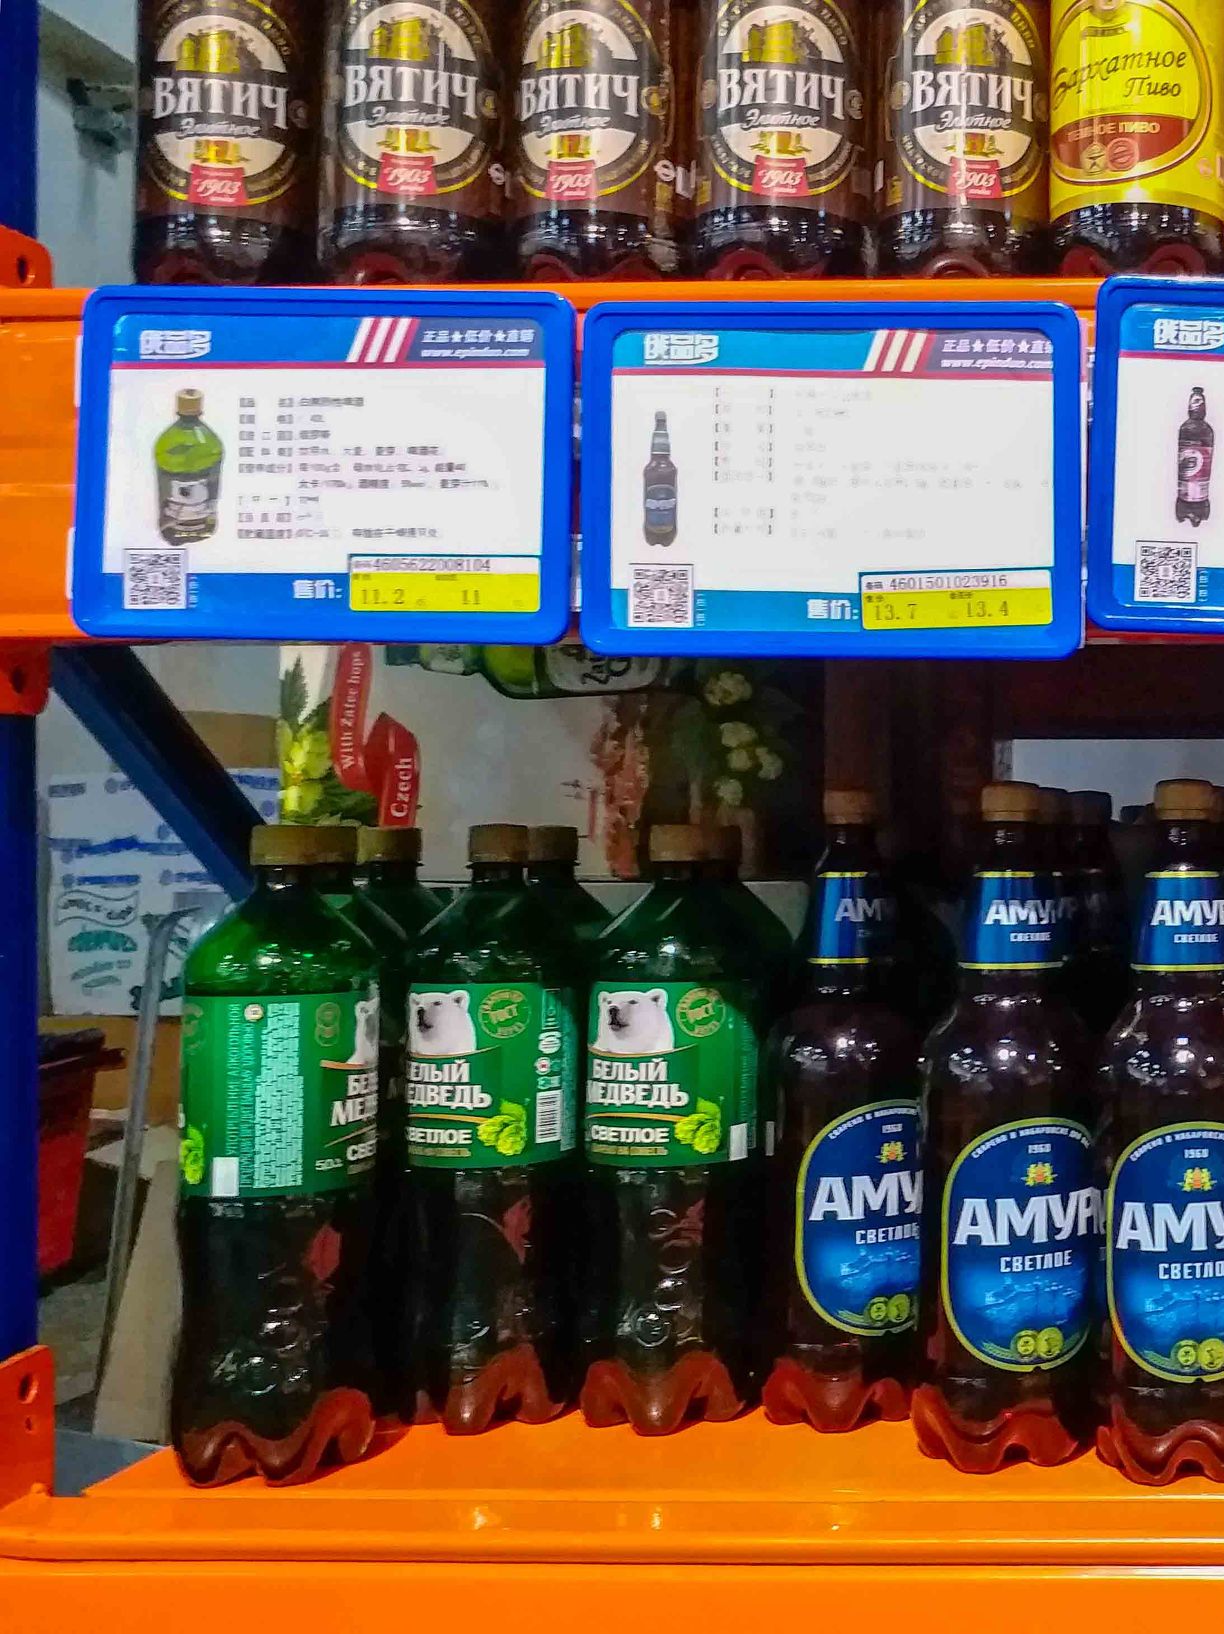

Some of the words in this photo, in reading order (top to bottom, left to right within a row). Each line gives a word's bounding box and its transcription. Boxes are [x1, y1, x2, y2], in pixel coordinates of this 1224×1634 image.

[153, 78, 288, 129] ВЯТИЧ
[344, 64, 478, 119] ВЯТИЧ
[520, 74, 639, 122] ВЯТИЧ
[719, 68, 845, 120] ВЯТИЧ
[910, 70, 1034, 122] ВЯТИЧ
[361, 588, 406, 606] 11.2
[461, 588, 482, 606] 11
[874, 603, 917, 621] 13.7
[966, 601, 1009, 618] 13.4
[390, 757, 413, 818] Czech
[592, 1058, 668, 1082] БЕЛЫЙ
[591, 1125, 670, 1143] СВЕТЛОЕ
[809, 1170, 924, 1221] АМУ
[1000, 1250, 1072, 1273] СВЕТЛОЕ
